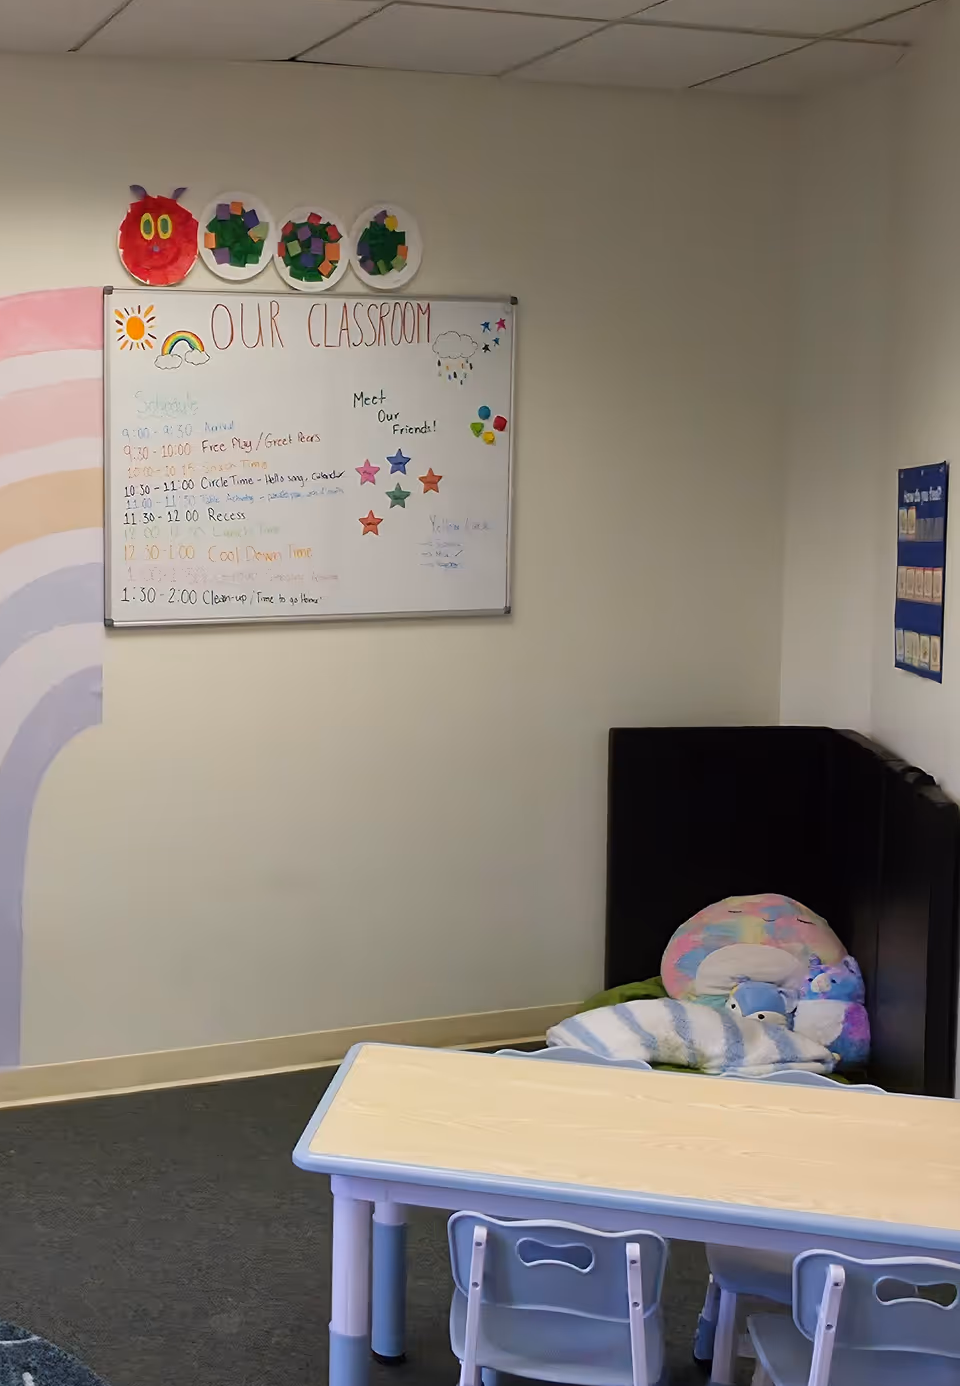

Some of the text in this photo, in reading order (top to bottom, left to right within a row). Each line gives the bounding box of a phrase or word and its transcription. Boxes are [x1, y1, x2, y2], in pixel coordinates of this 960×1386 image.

[211, 300, 431, 350] OUR CLASSROOM
[353, 389, 387, 408] Meet
[378, 409, 400, 423] Our
[392, 420, 437, 435] Friends!
[201, 439, 227, 453] Free
[200, 476, 228, 490] Circle
[229, 474, 254, 486] Time
[207, 507, 246, 523] Recess
[121, 586, 157, 603] 1:30
[168, 587, 198, 605] 2:00
